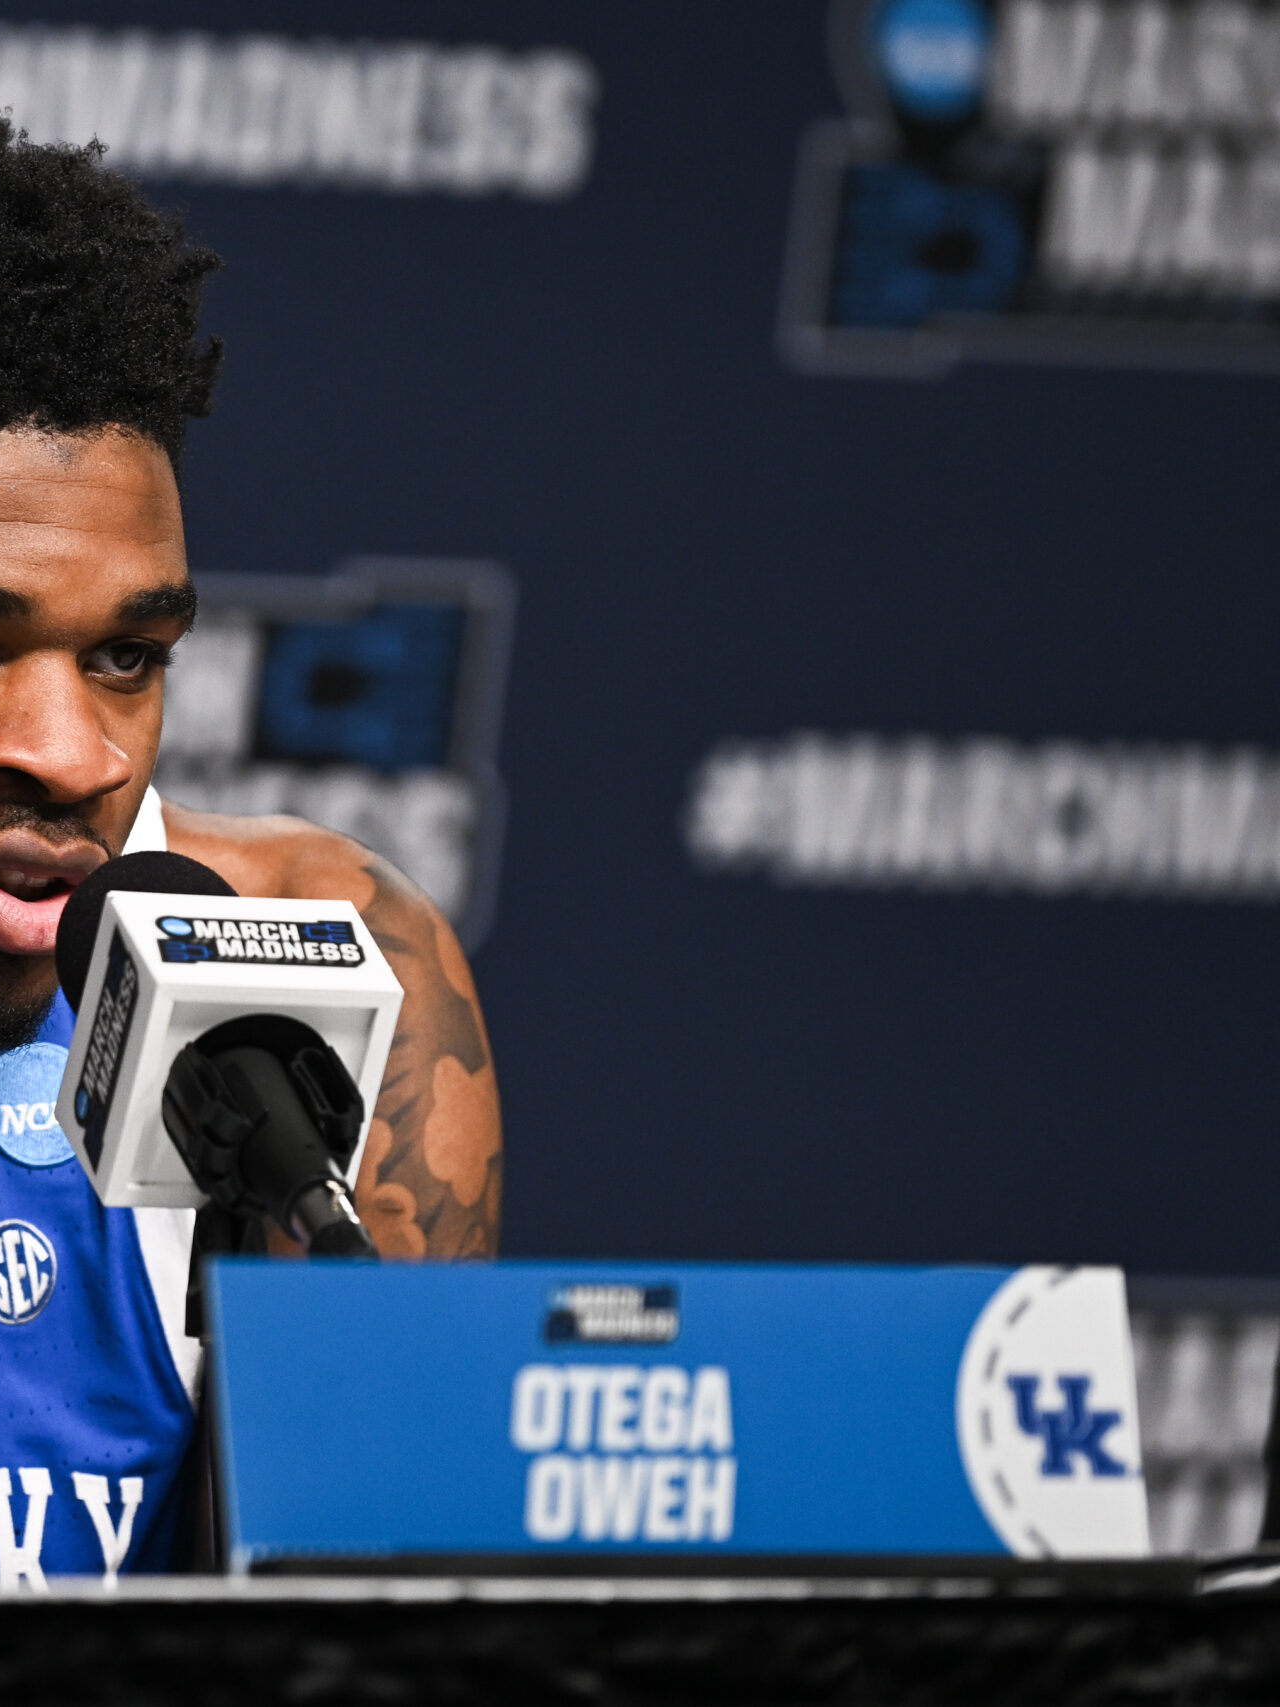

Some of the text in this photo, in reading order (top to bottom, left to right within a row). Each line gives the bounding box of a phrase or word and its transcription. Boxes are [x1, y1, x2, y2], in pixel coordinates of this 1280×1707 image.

[193, 919, 301, 942] MARCH
[216, 938, 361, 962] MADNESS
[82, 985, 115, 1098] MARCH
[95, 959, 137, 1104] MADNESS
[0, 1101, 60, 1135] NC
[511, 1364, 733, 1451] OTEGA
[1006, 1375, 1126, 1477] UK
[524, 1454, 736, 1541] OWEH
